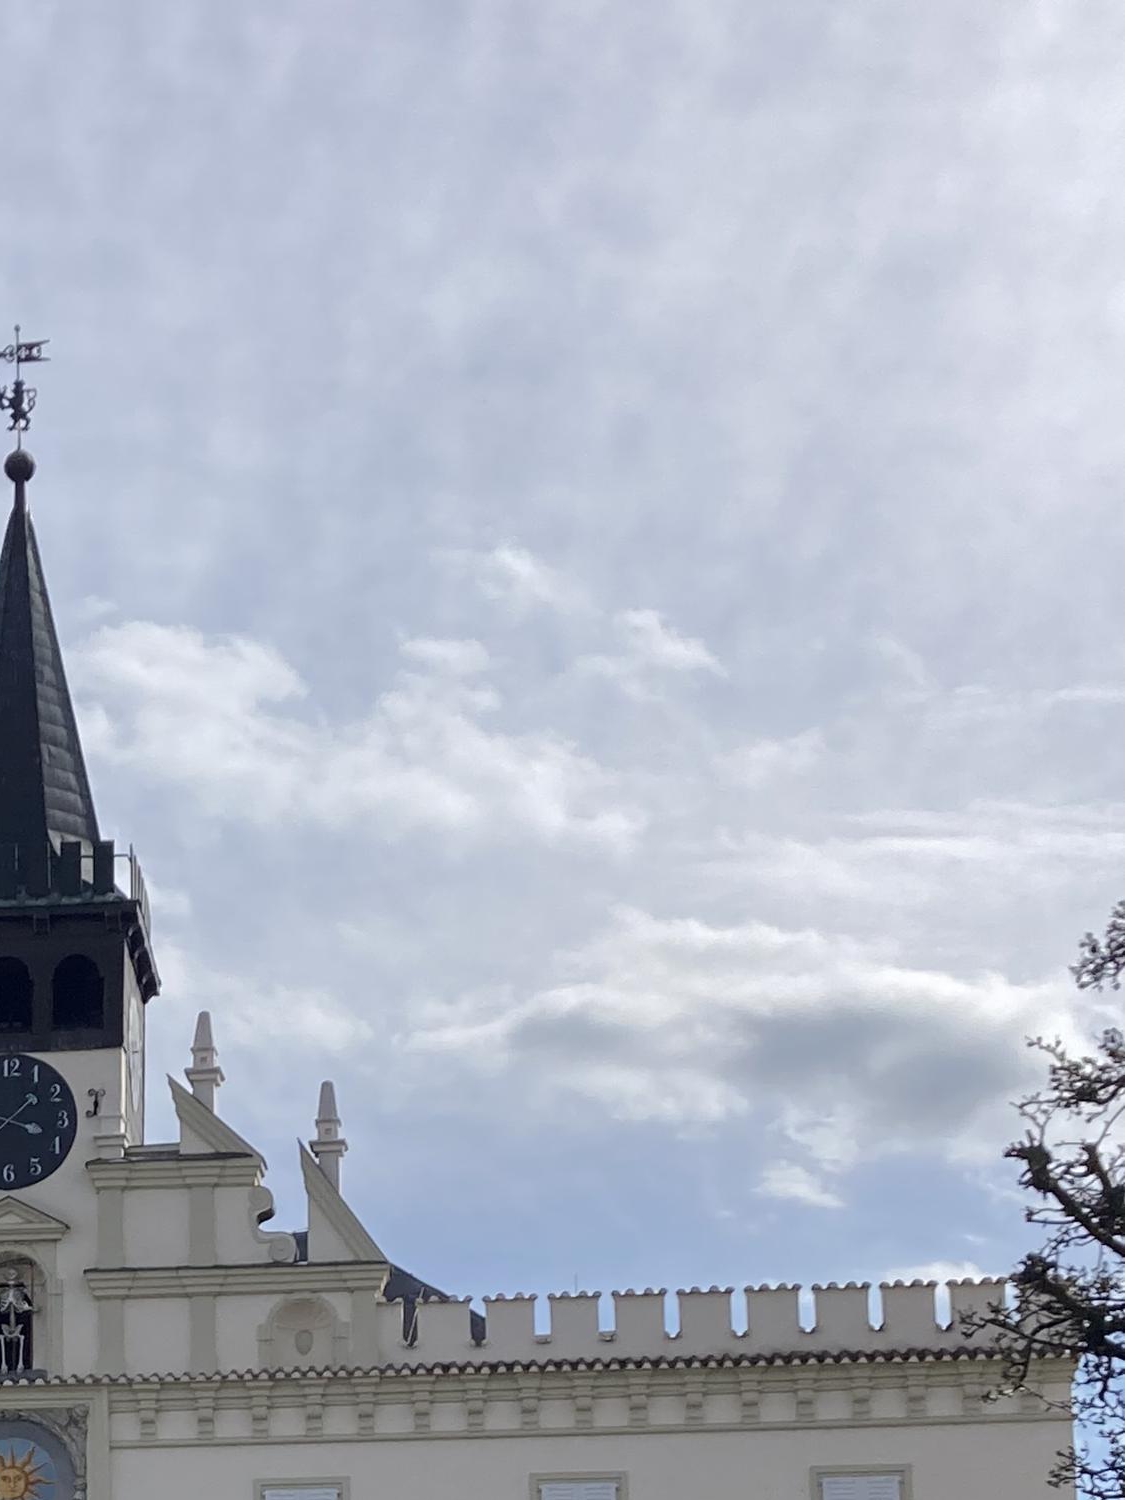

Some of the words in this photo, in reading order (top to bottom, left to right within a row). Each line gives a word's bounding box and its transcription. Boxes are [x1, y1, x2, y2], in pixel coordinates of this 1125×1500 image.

[3, 1058, 21, 1077] 12
[32, 1064, 39, 1083] 1
[50, 1083, 62, 1102] 2
[58, 1110, 69, 1128] 3
[49, 1136, 60, 1154] 4
[3, 1164, 15, 1182] 6
[29, 1157, 42, 1175] 5
